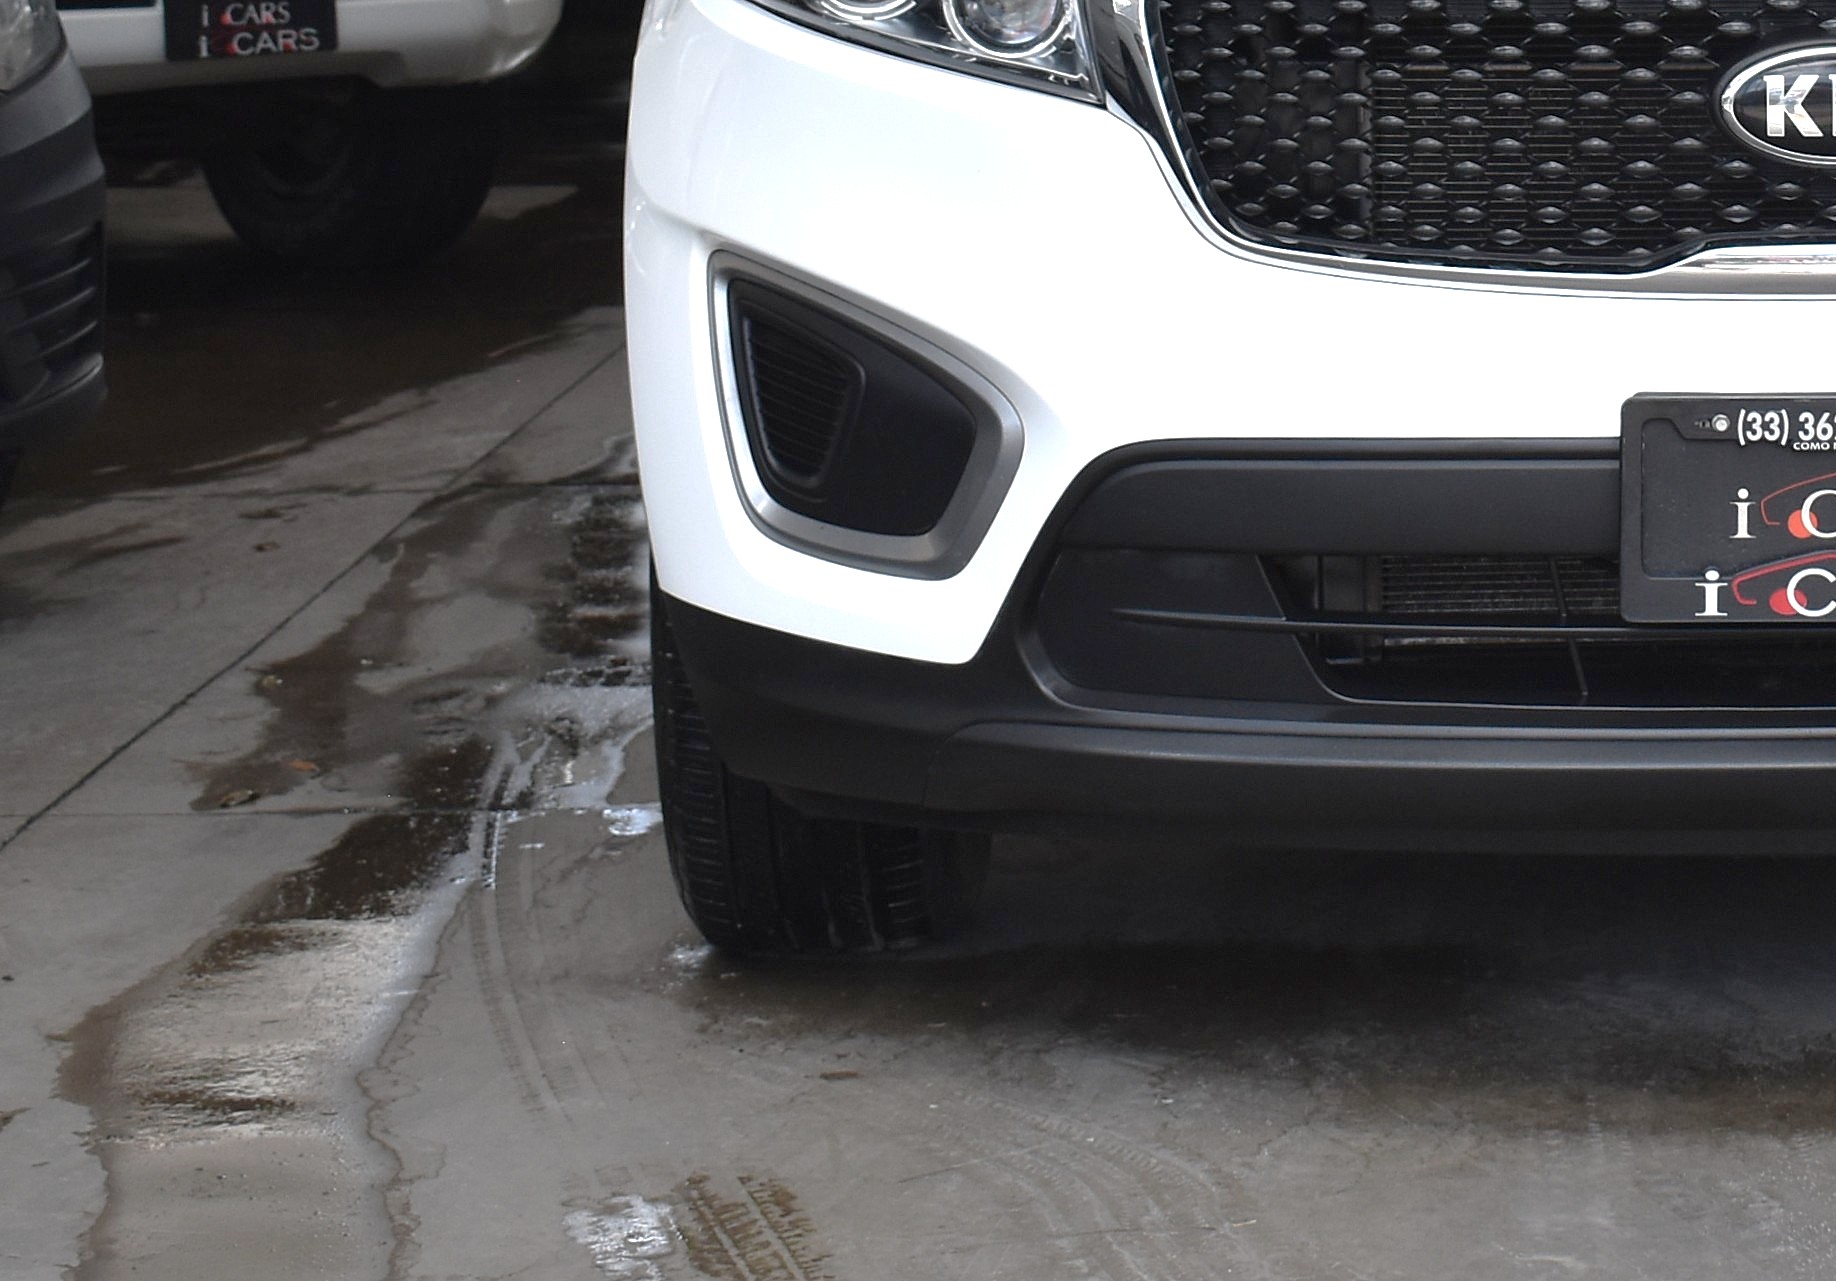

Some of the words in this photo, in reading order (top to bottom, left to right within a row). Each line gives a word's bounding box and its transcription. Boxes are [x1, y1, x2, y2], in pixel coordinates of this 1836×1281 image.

[225, 1, 292, 26] CARS
[232, 27, 321, 57] CARS
[1737, 409, 1790, 446] (33)
[1793, 441, 1831, 451] COMO
[1729, 487, 1756, 539] i
[1694, 569, 1729, 617] i
